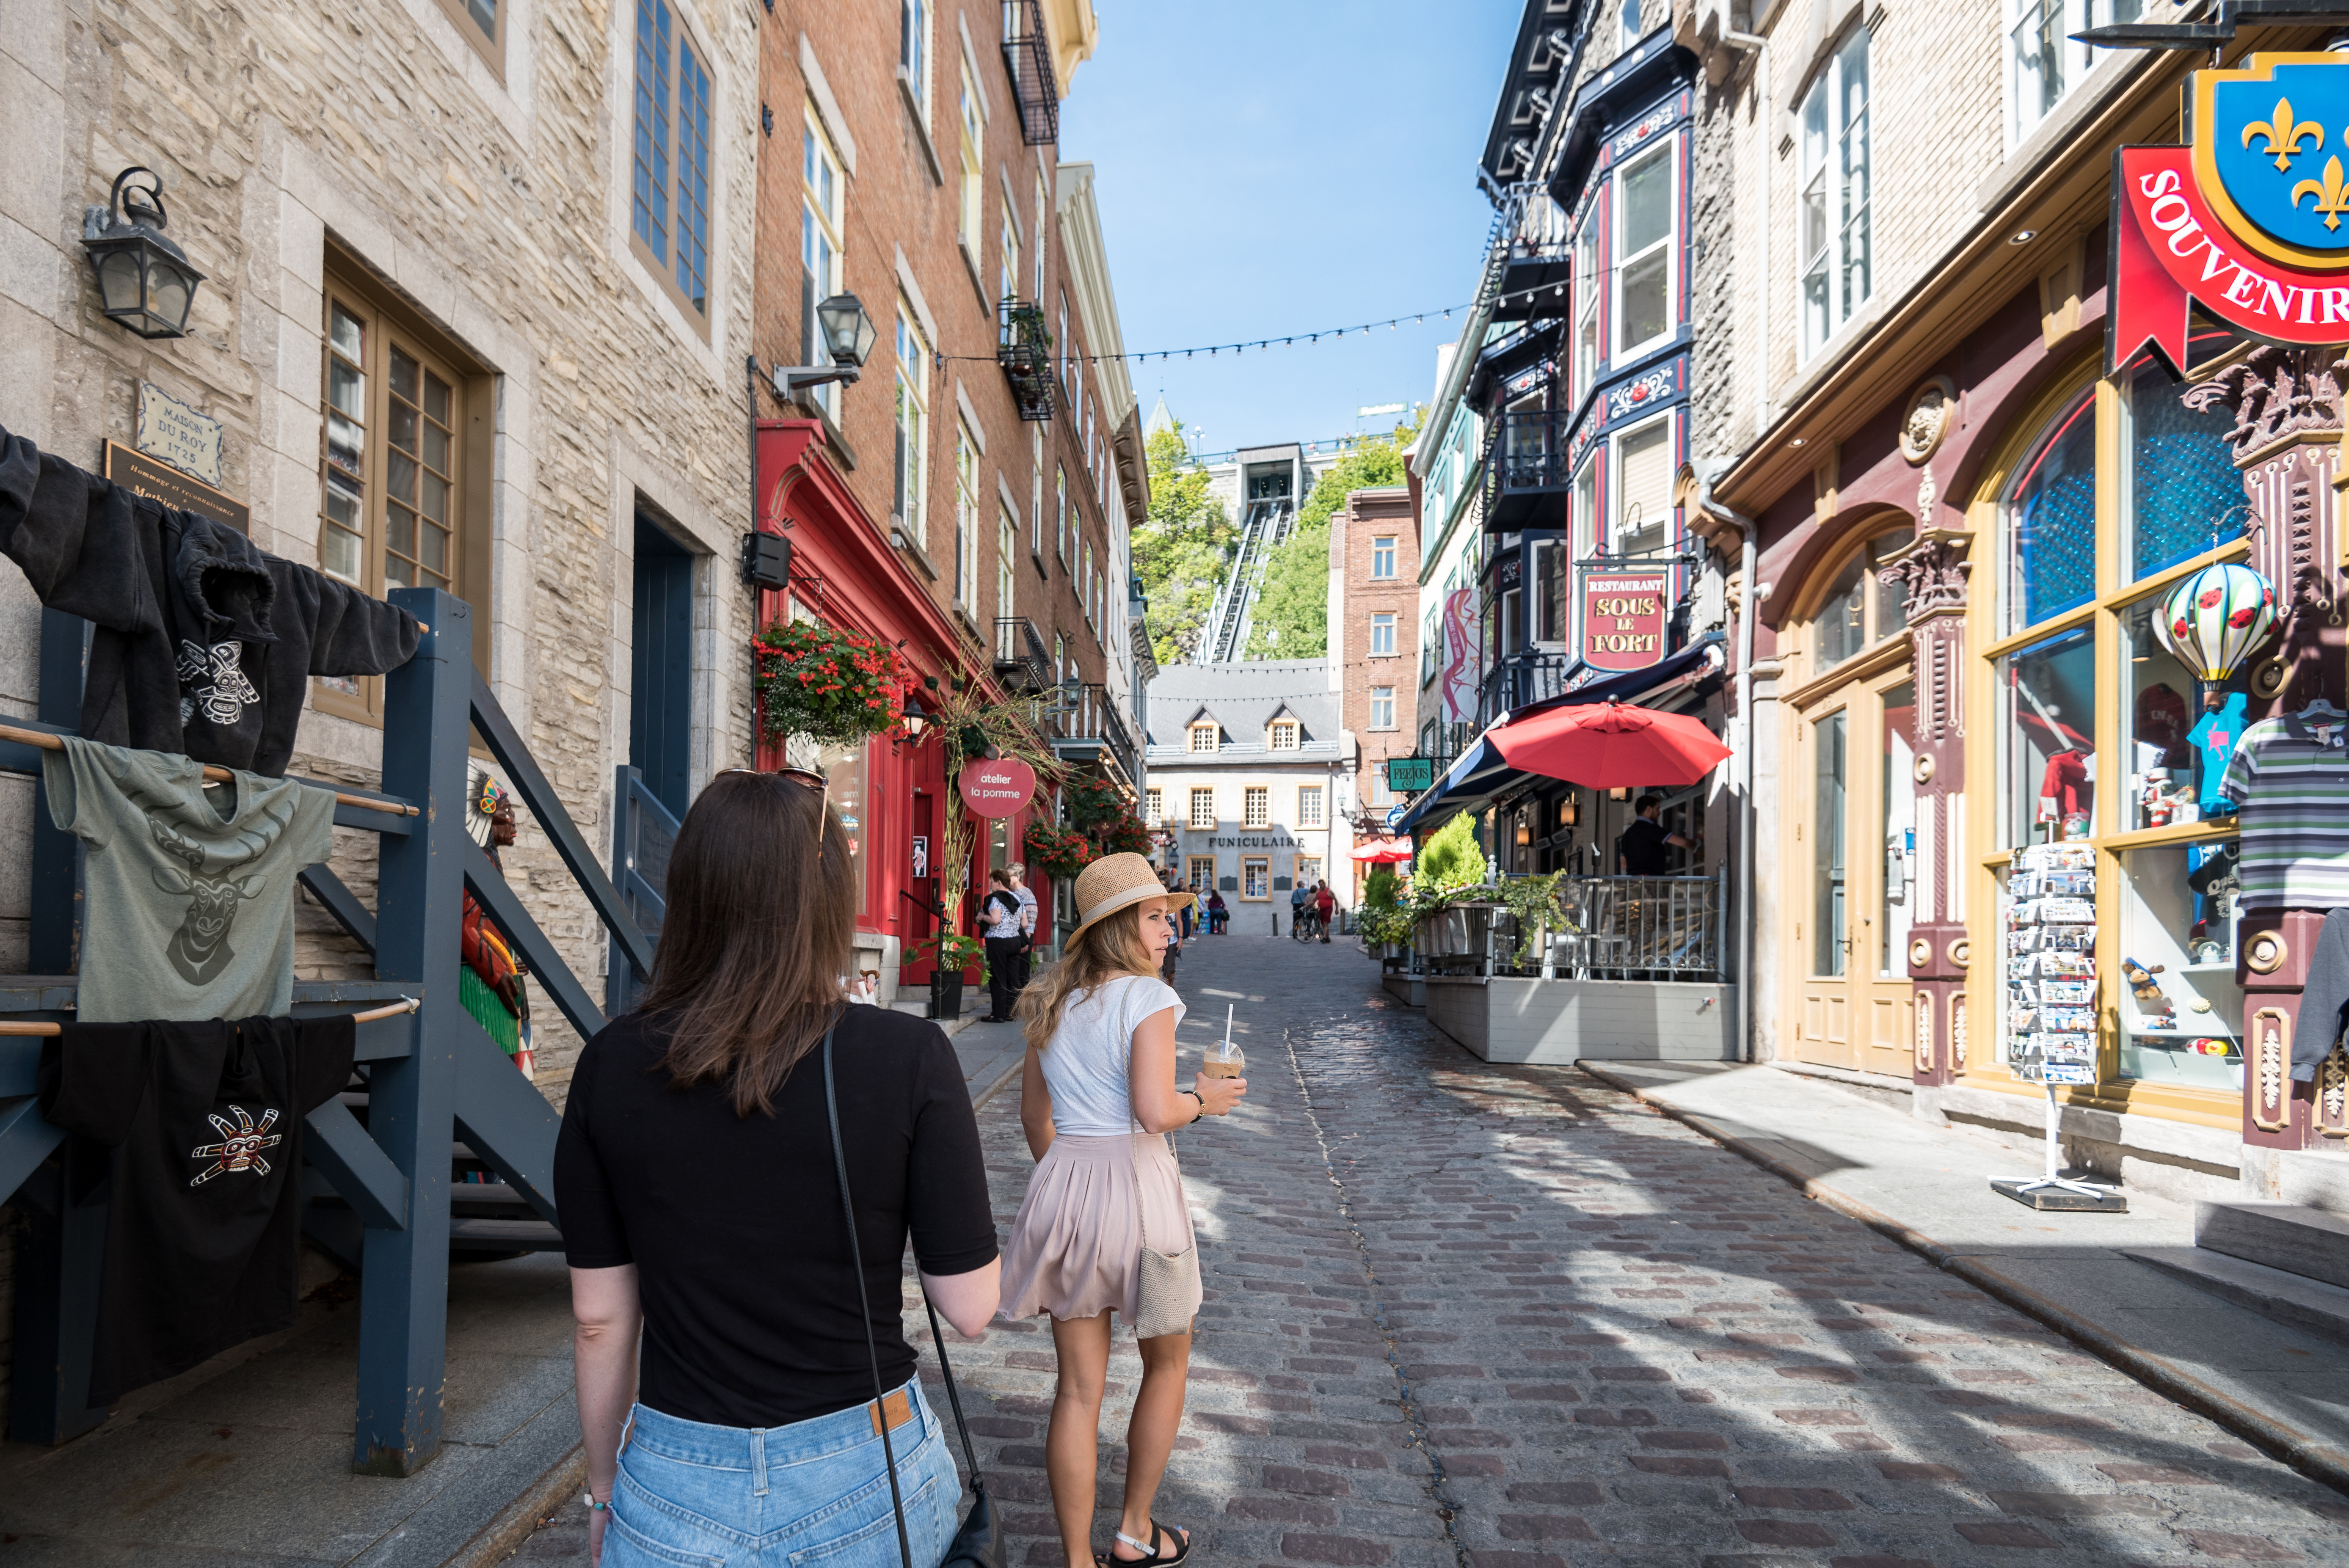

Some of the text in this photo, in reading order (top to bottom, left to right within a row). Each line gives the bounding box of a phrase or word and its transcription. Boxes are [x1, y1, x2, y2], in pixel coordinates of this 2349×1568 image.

[164, 407, 203, 436] MAISON
[159, 419, 207, 452] DU ROY
[168, 442, 196, 463] 1725
[130, 464, 169, 487] Hommage
[182, 489, 234, 517] reconnaissance
[1588, 579, 1663, 592] RESTAURANT
[1594, 597, 1656, 618] SOUS
[1615, 618, 1634, 631] LE
[1590, 634, 1658, 654] FORT
[981, 773, 1012, 784] atelier
[971, 786, 1020, 799] la pomme
[1209, 837, 1305, 848] FUNICULAIRE
